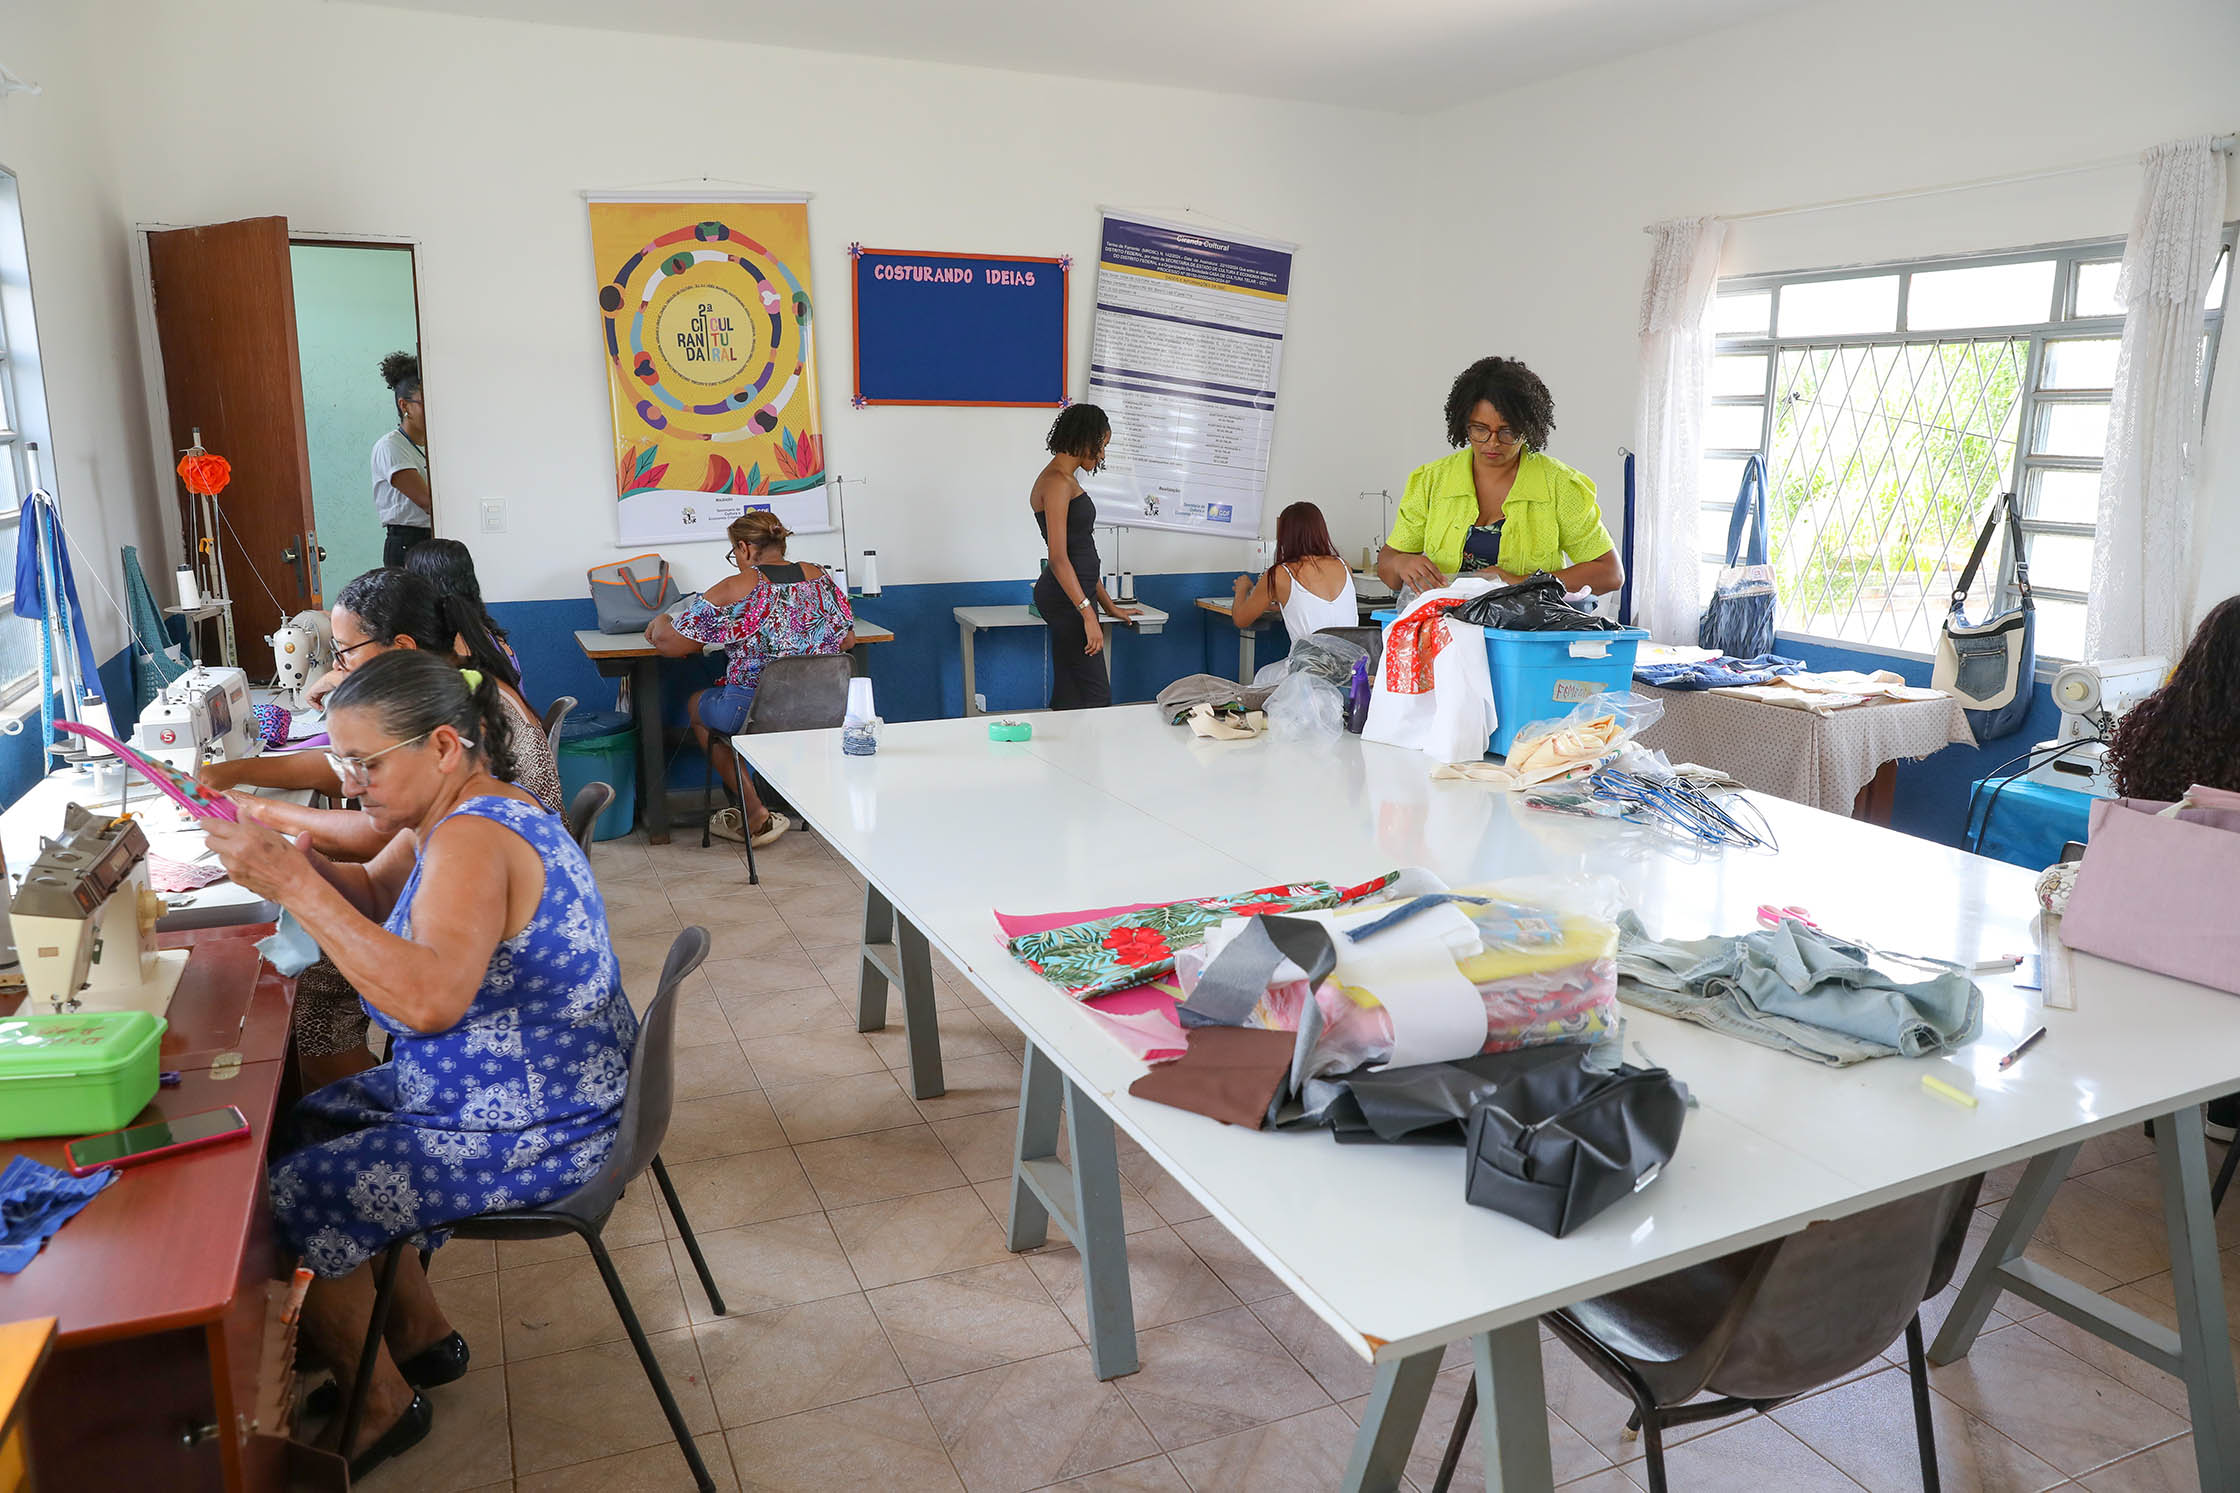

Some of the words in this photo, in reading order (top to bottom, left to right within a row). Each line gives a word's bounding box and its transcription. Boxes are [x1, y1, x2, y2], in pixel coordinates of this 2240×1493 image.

[874, 264, 973, 284] COSTURANDO
[985, 269, 1036, 287] IDEIAS
[691, 318, 704, 332] CI
[710, 317, 734, 331] CUL
[677, 333, 705, 348] RAN
[711, 332, 729, 347] TU
[686, 347, 706, 361] DA
[711, 347, 737, 361] RAL
